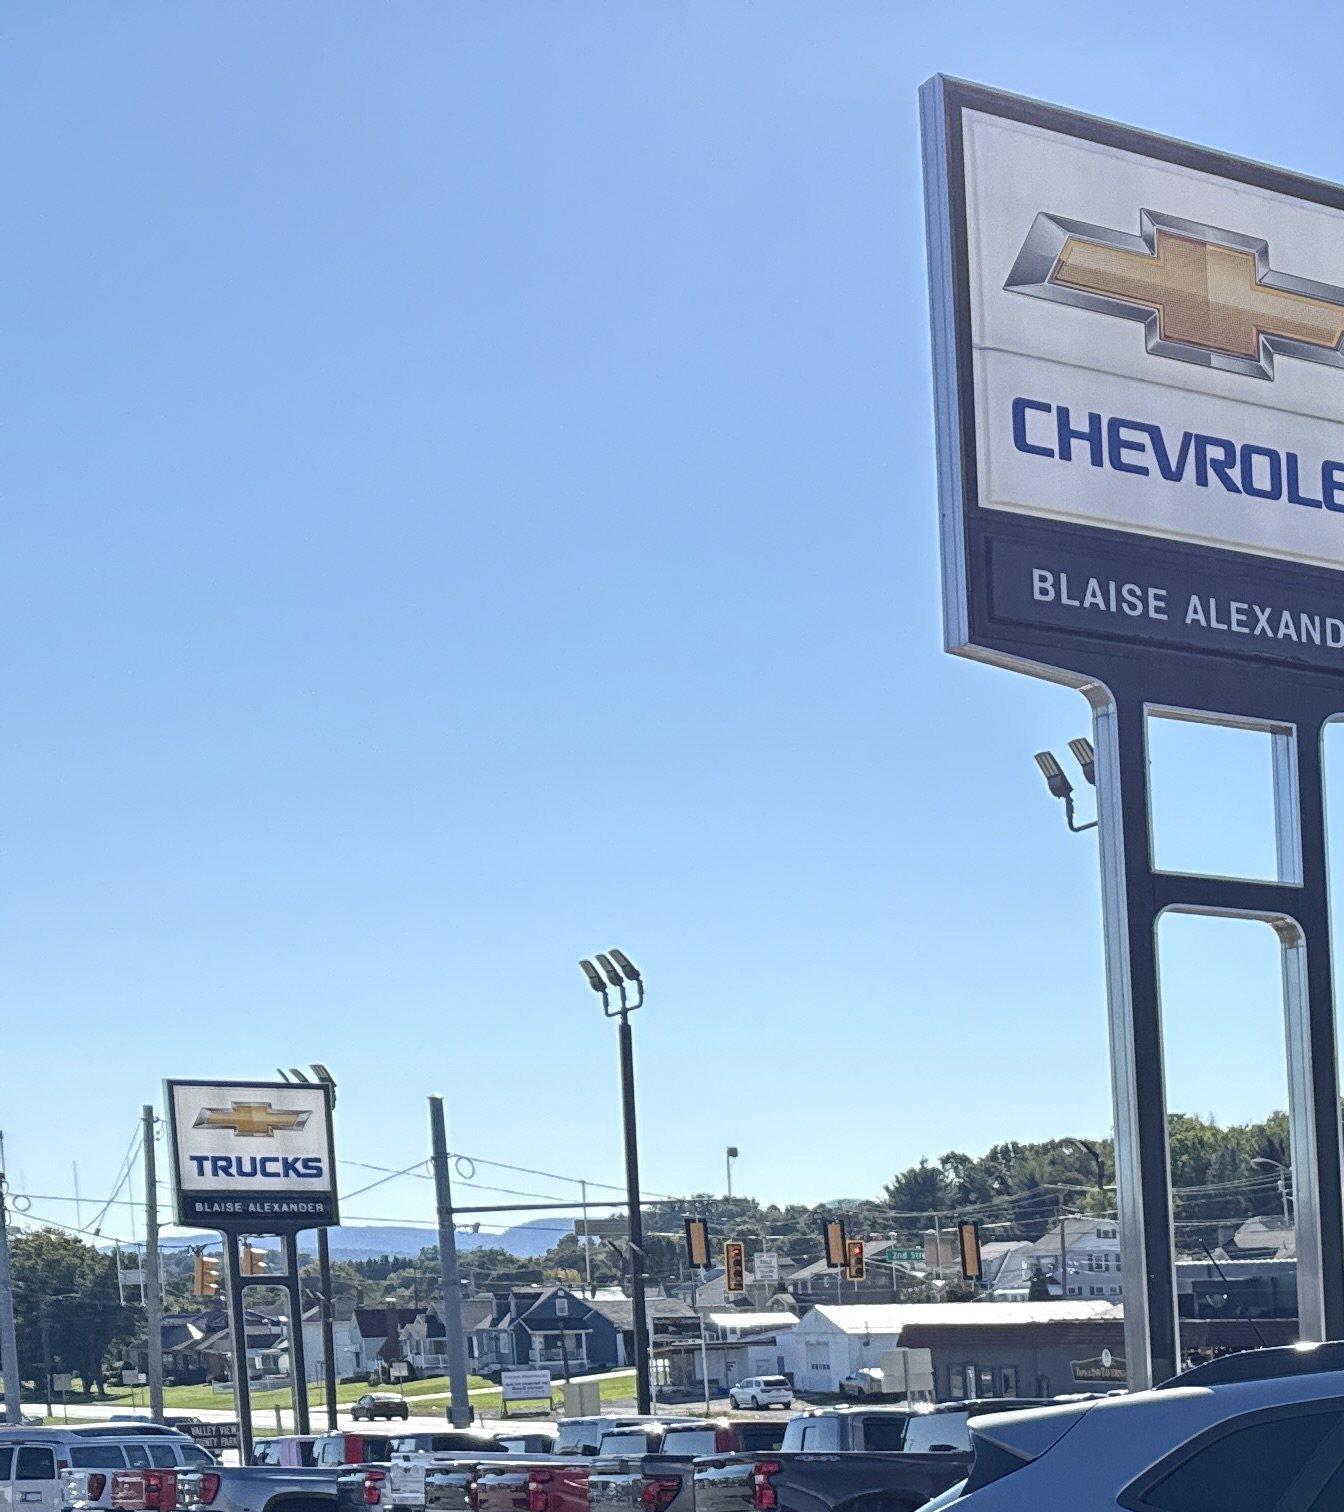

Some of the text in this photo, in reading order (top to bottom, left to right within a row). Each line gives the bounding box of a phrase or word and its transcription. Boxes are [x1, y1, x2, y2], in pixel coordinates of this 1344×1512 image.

[1032, 567, 1169, 622] BLAISE
[189, 1155, 323, 1178] TRUCKS
[195, 1202, 325, 1213] BLAISE ALEXANDER
[892, 1252, 908, 1260] 2nd
[190, 1425, 237, 1436] VALLEY VIEW
